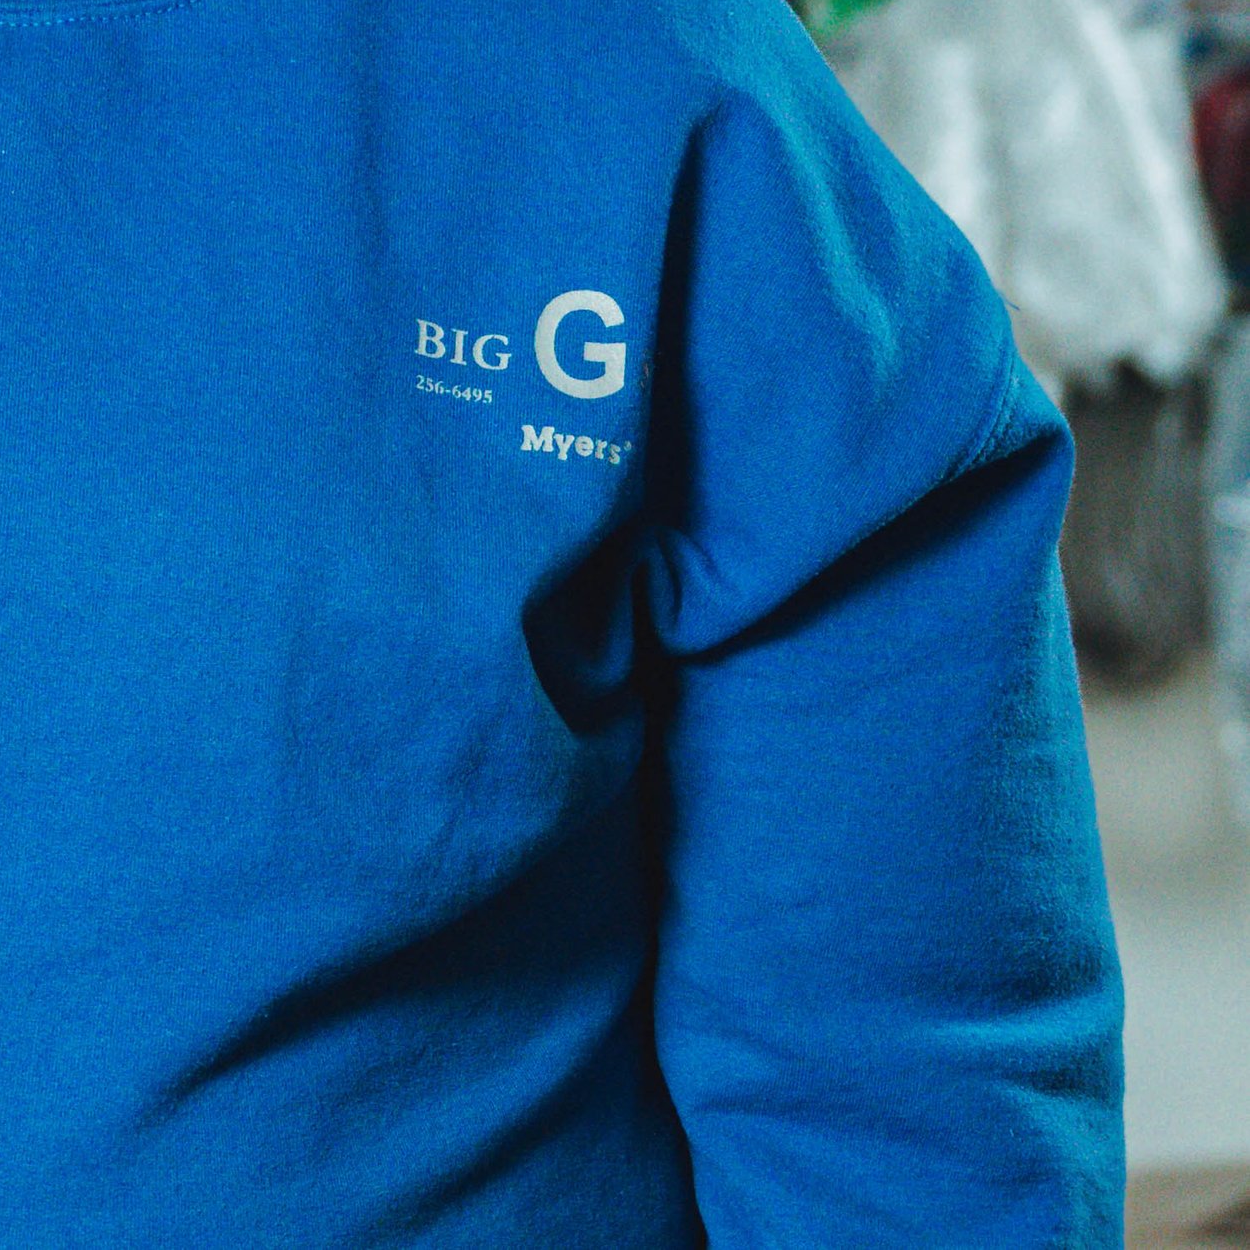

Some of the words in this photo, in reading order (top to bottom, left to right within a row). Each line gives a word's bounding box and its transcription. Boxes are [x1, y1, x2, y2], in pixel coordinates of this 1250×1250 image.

[415, 318, 512, 371] BIG
[534, 289, 627, 399] G
[416, 374, 493, 404] 256-6495
